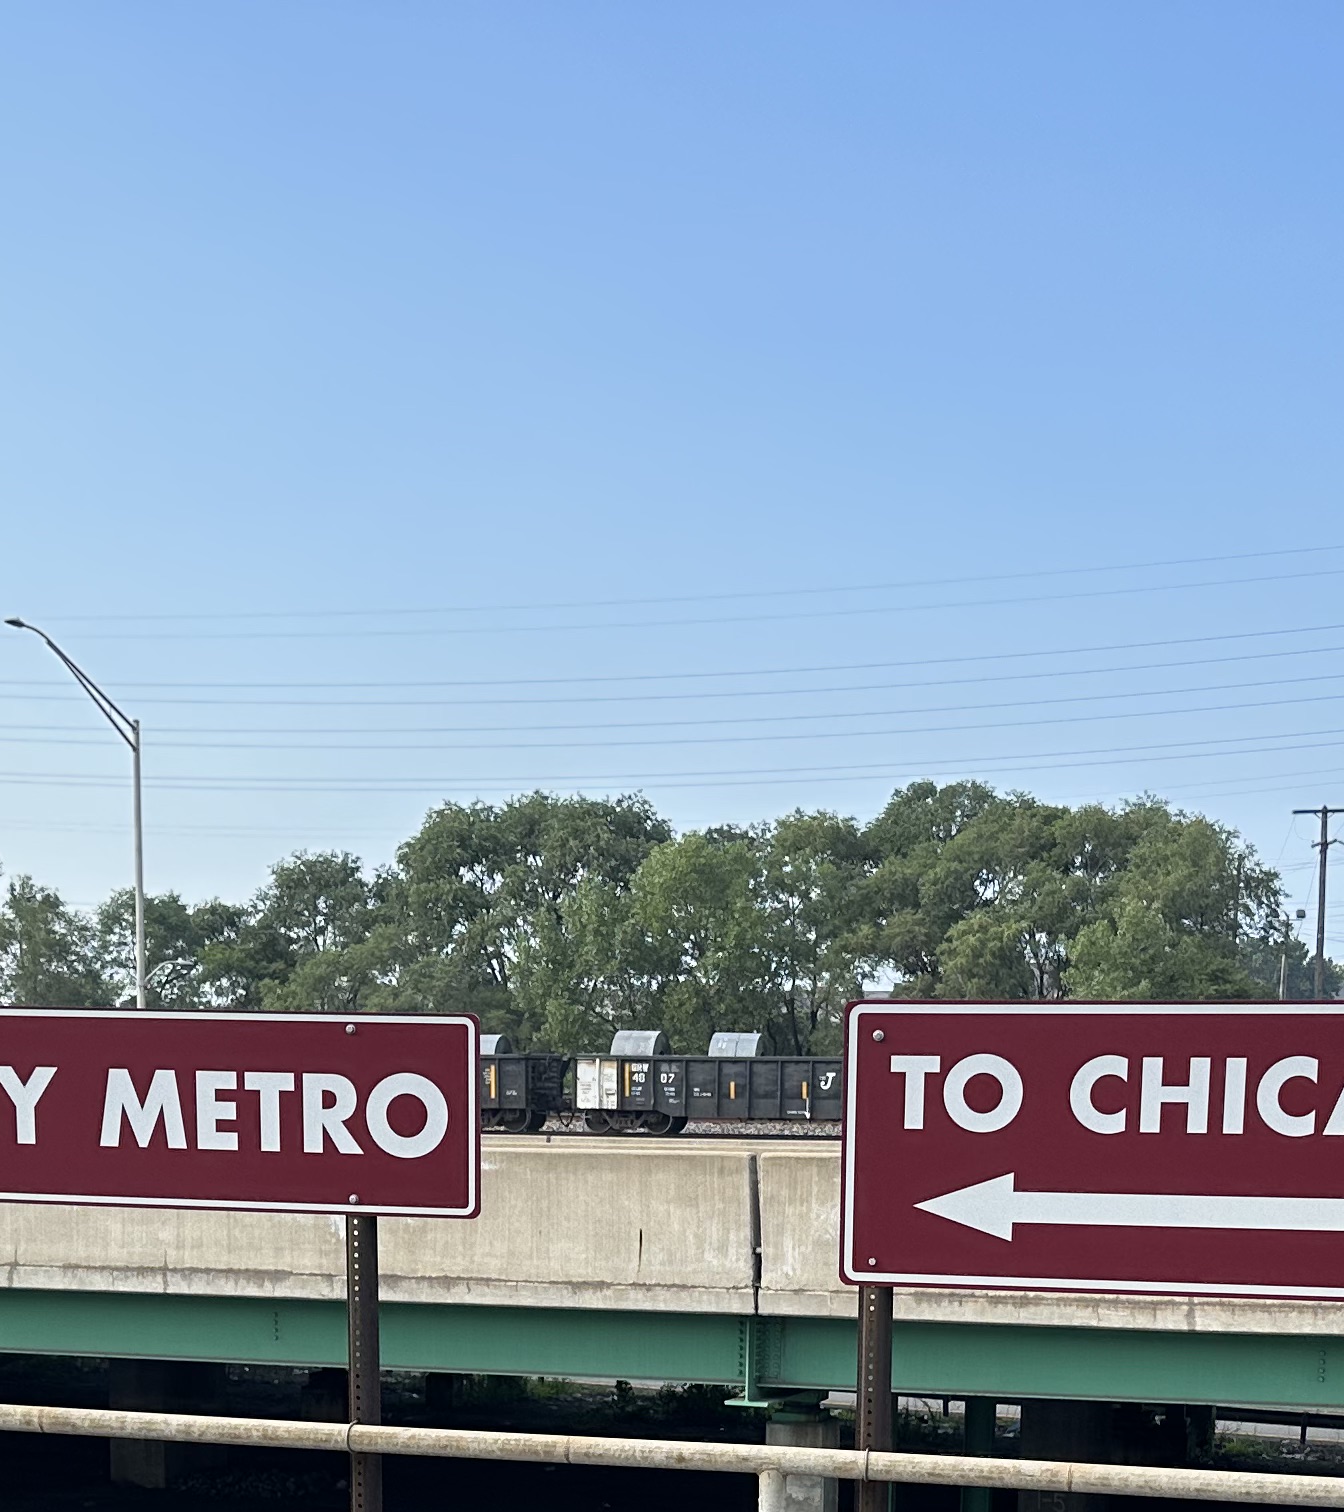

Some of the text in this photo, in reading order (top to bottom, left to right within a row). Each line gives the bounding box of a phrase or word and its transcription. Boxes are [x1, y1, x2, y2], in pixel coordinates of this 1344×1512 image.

[99, 1068, 449, 1159] METRO
[660, 1073, 676, 1084] 07
[890, 1053, 1024, 1133] TO
